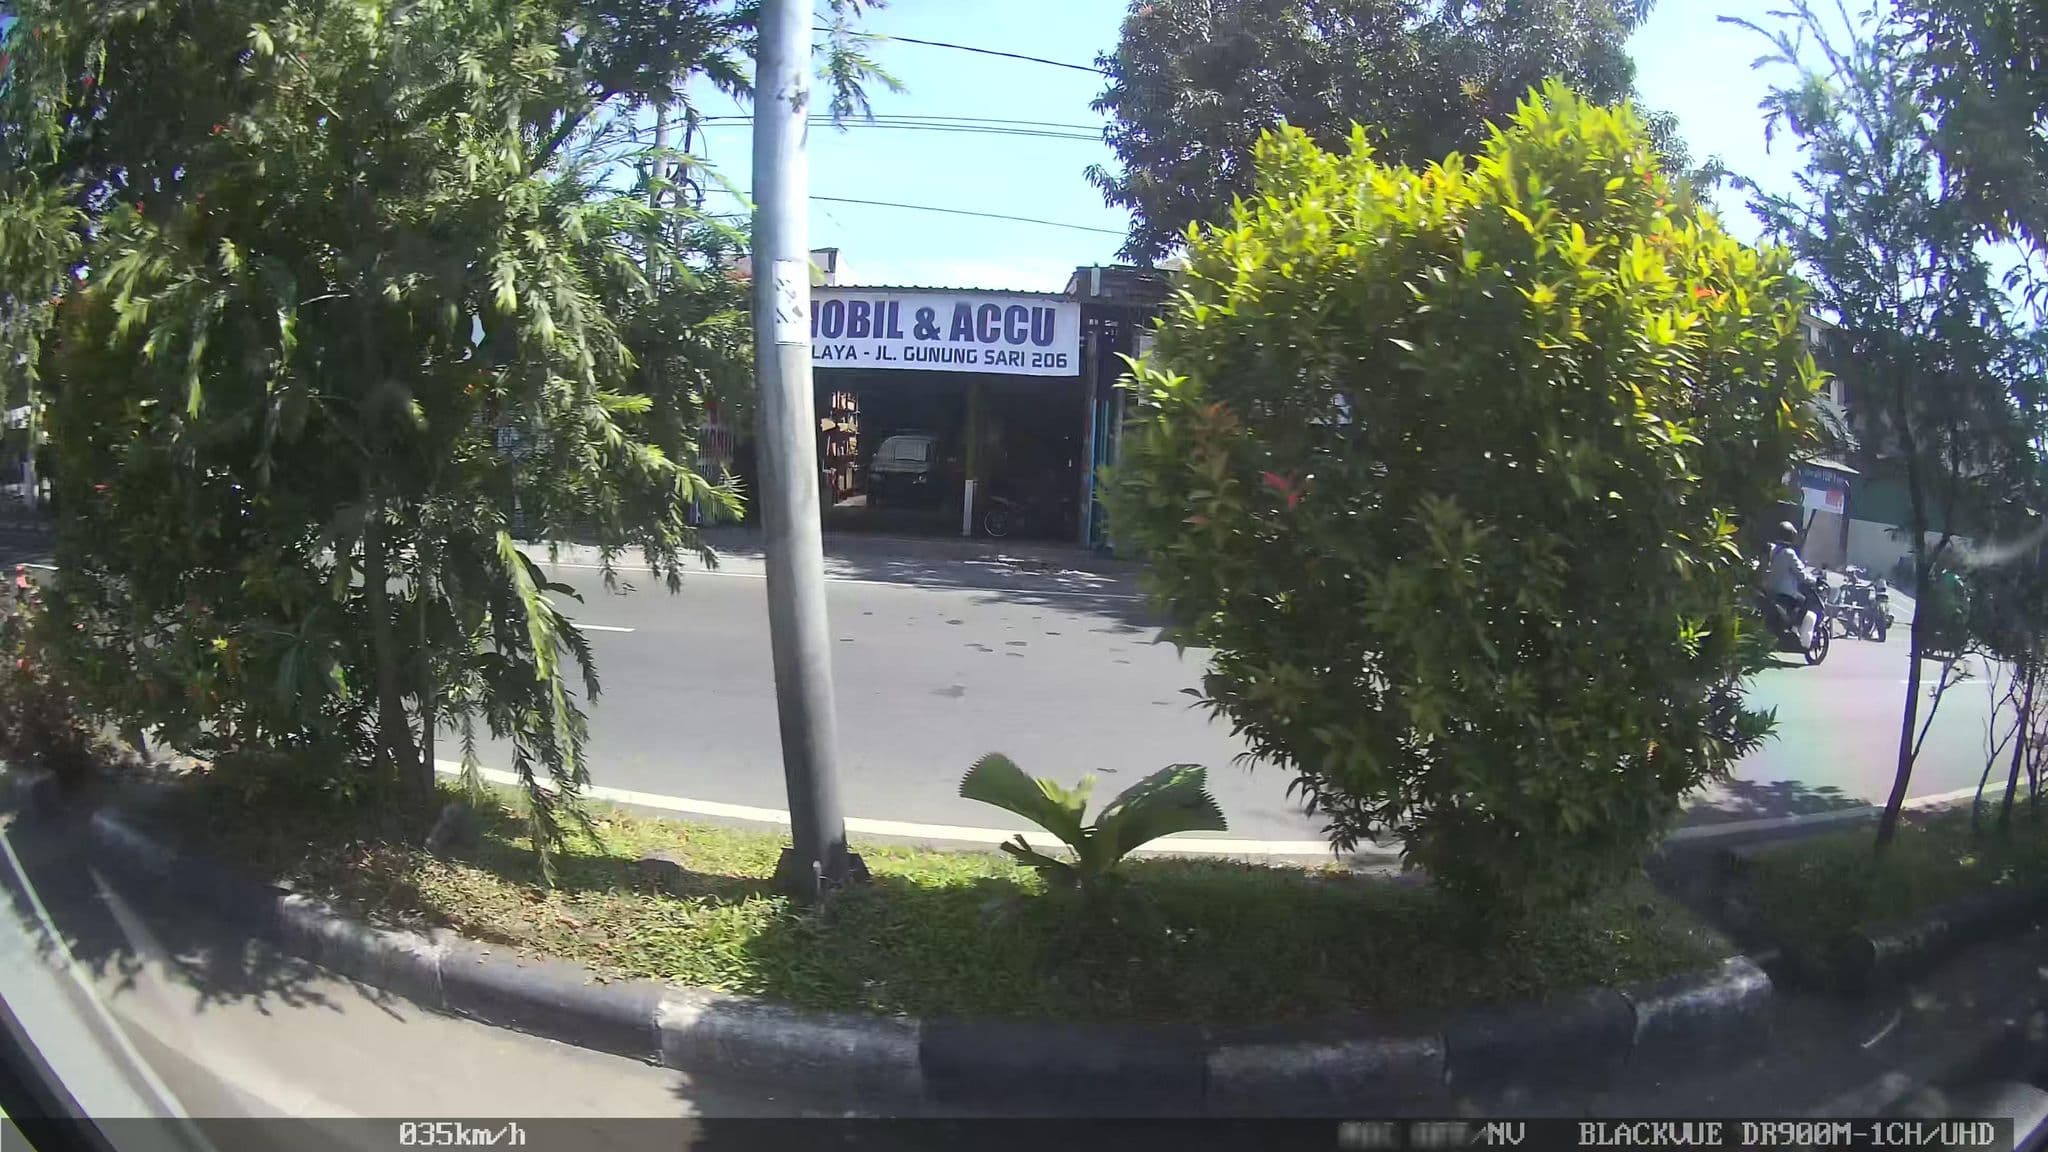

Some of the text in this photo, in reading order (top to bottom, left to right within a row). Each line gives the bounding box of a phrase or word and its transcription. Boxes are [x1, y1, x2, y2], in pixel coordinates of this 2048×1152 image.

[913, 306, 941, 341] &
[949, 301, 1056, 347] ACCU
[875, 345, 897, 361] JL.
[903, 346, 978, 364] GUNUNG
[984, 349, 1025, 367] SARI
[1031, 352, 1068, 368] 206
